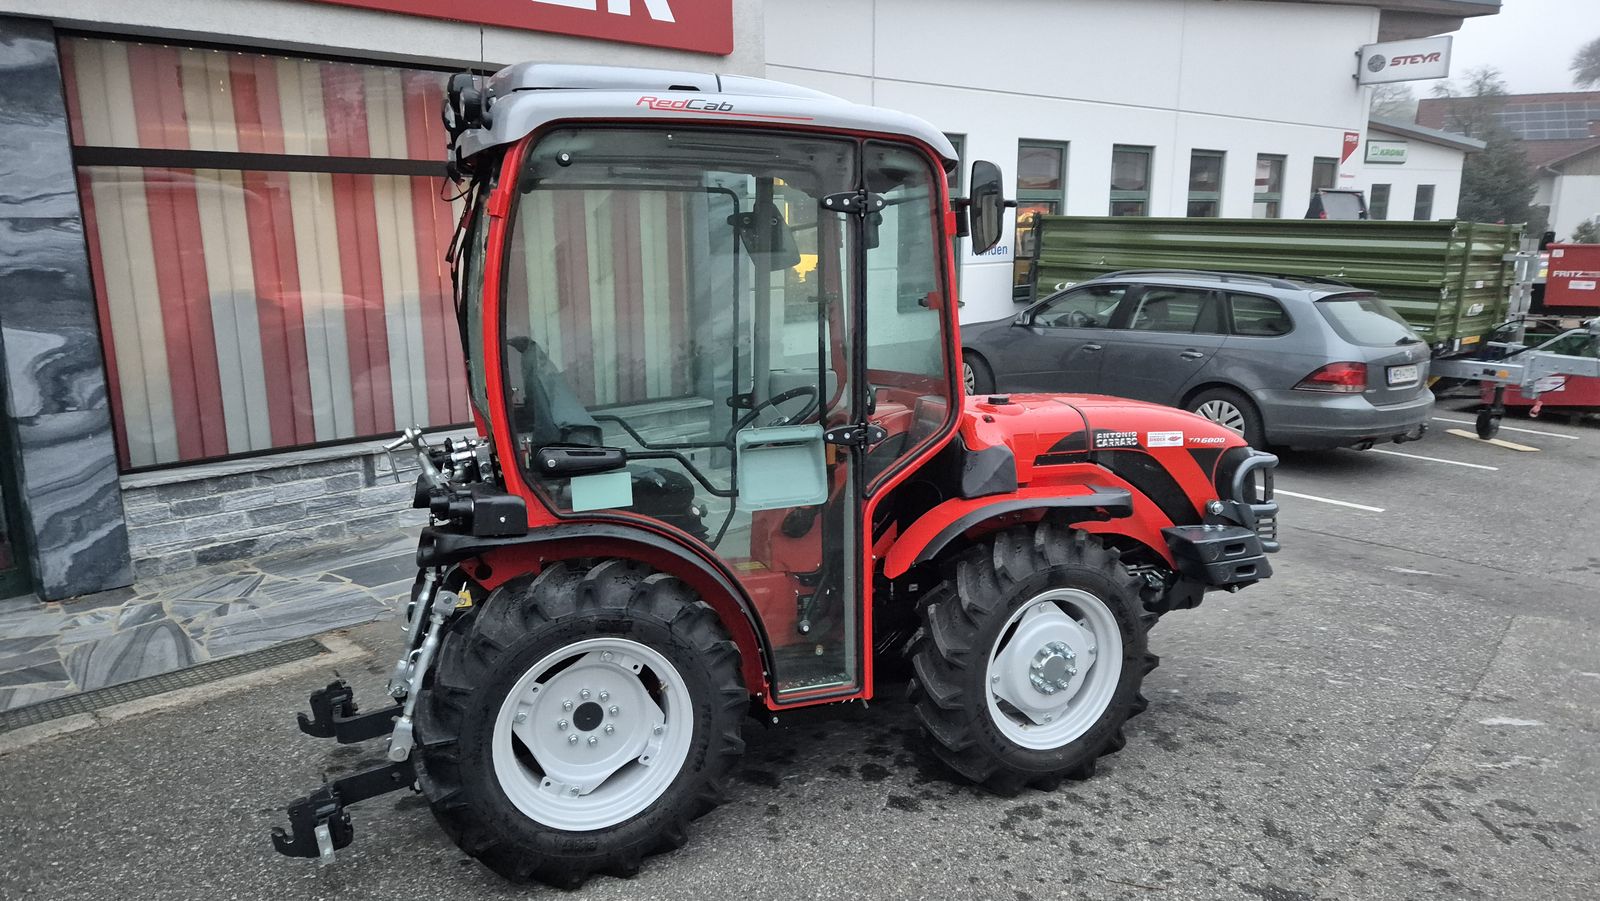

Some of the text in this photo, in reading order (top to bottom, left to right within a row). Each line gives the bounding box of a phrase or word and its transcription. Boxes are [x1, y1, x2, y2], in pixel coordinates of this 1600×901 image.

[1389, 52, 1441, 67] STEYR
[636, 96, 733, 112] RedCab
[1096, 431, 1138, 439] ANTONIO
[1096, 438, 1138, 447] CARRARO
